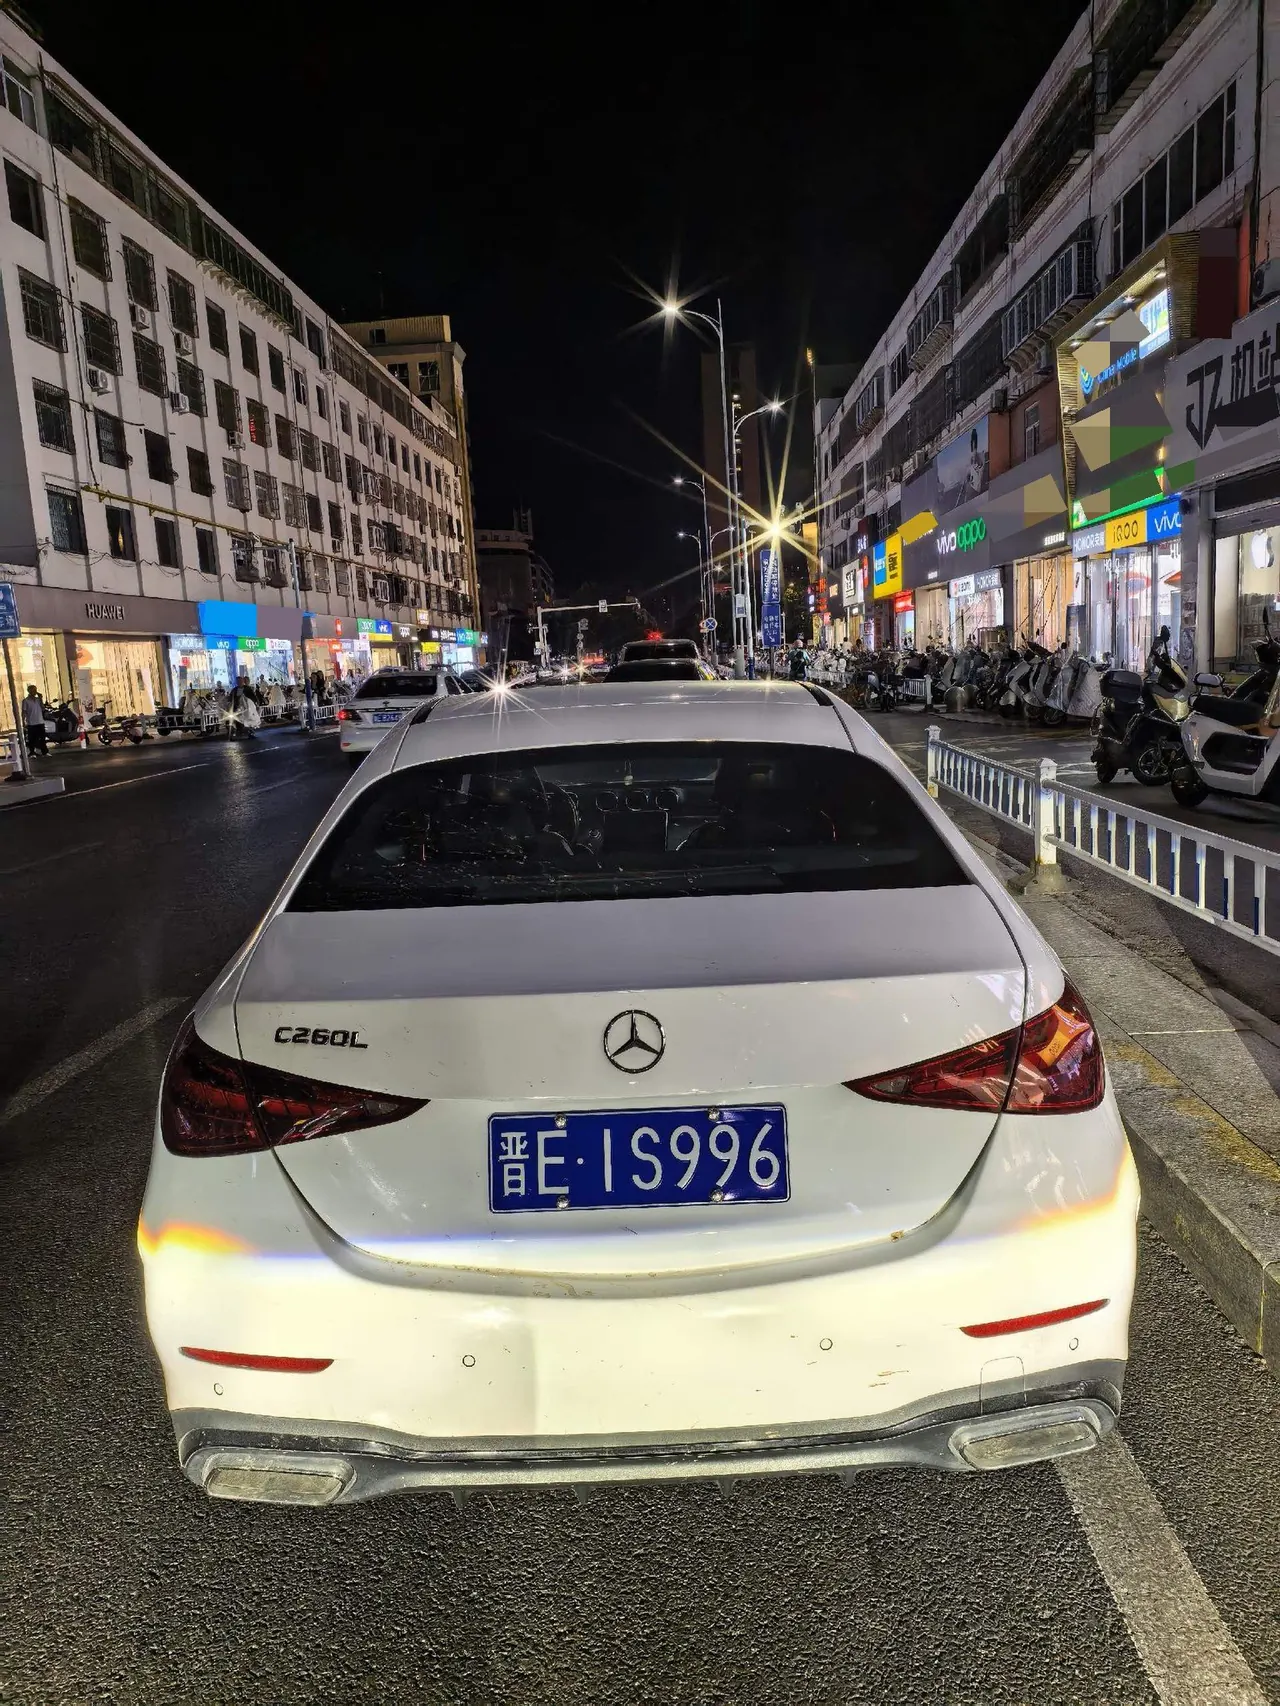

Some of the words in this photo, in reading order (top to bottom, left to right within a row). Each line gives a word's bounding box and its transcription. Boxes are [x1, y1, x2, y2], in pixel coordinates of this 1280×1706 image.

[936, 530, 957, 554] vivo
[957, 517, 986, 552] oppo
[1112, 520, 1139, 543] iQOO
[85, 603, 125, 620] HUAWEI
[216, 639, 230, 649] vivo
[245, 639, 259, 649] oppo
[274, 1026, 369, 1049] C260L
